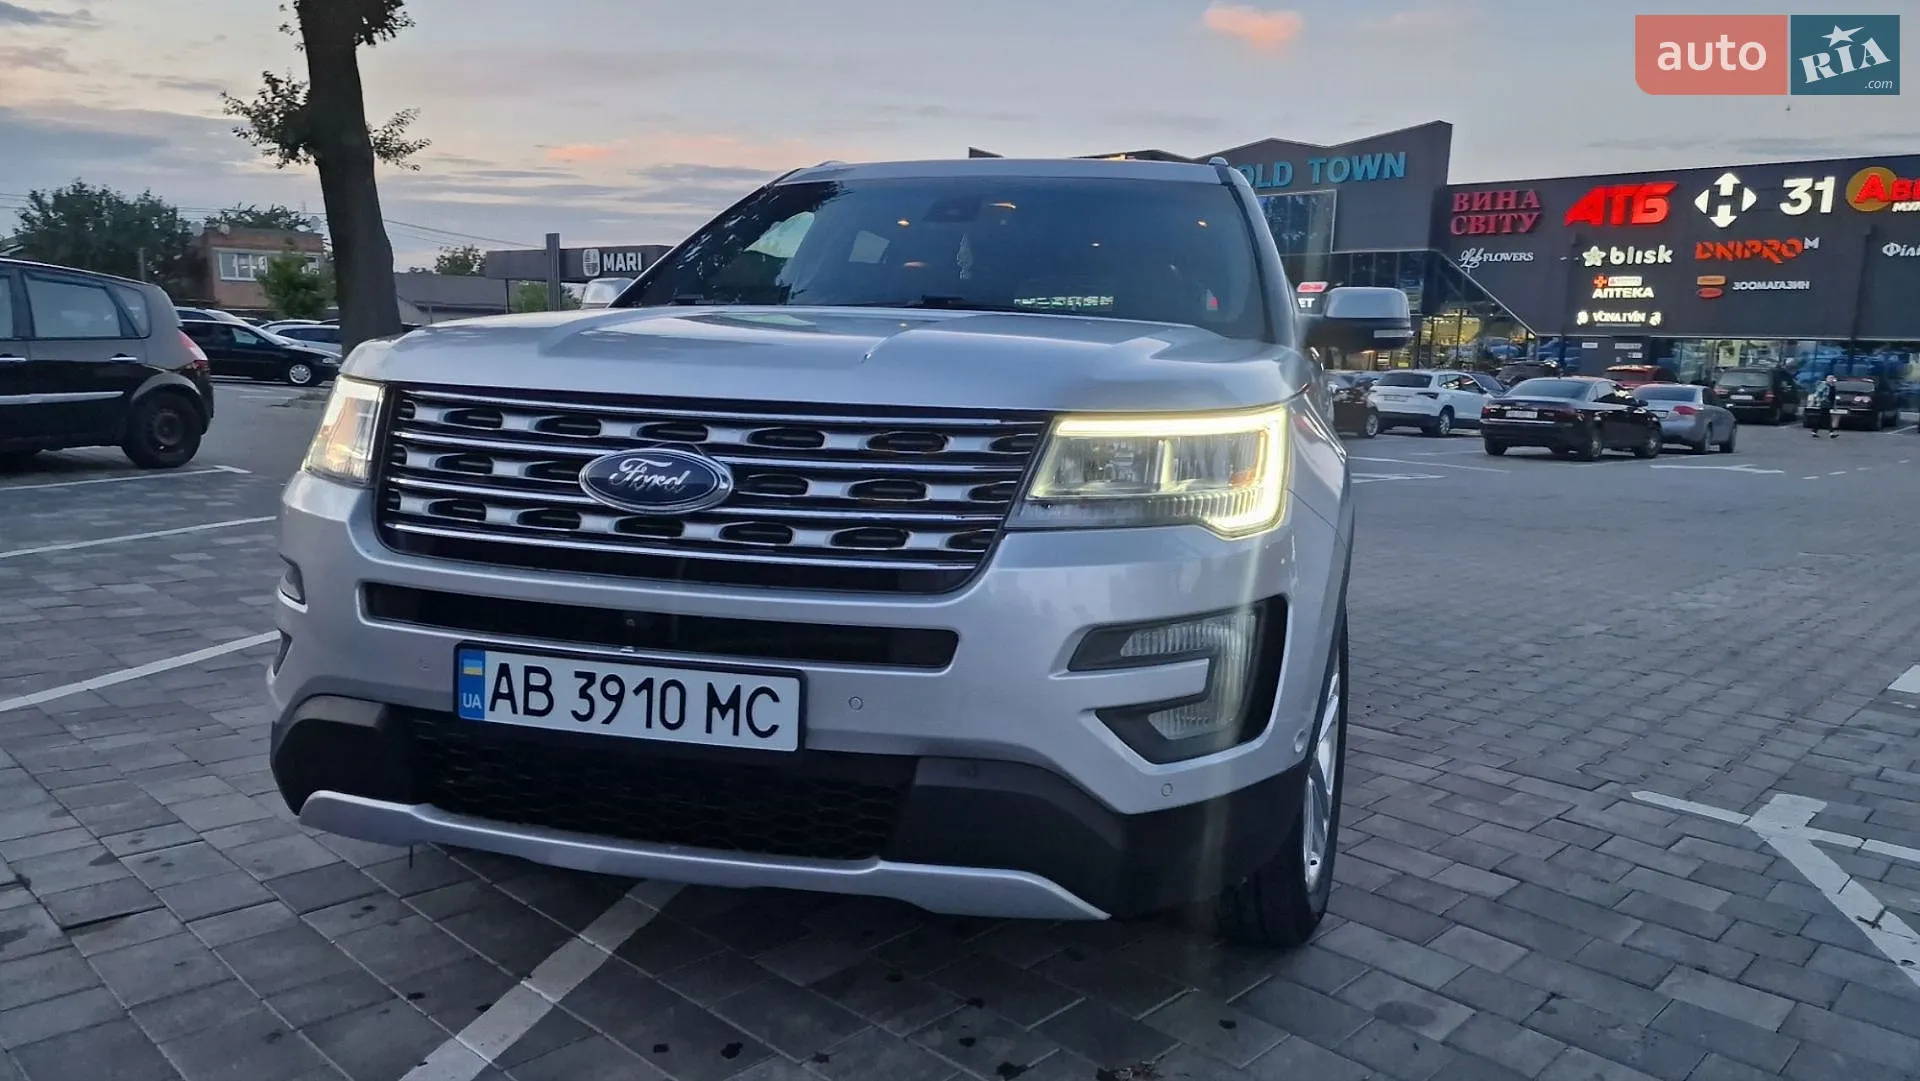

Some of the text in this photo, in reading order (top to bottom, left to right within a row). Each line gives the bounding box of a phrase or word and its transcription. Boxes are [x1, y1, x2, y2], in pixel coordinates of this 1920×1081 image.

[1239, 152, 1406, 188] OLD TOWN
[1452, 189, 1541, 212] ВИНА
[1564, 181, 1678, 226] АТБ
[1779, 176, 1836, 216] 31
[1450, 212, 1541, 235] СВІТУ
[603, 252, 642, 272] MARI
[1483, 252, 1534, 262] FLOWERS
[1609, 245, 1673, 265] blisk
[1695, 238, 1803, 263] DNIPRO
[1592, 287, 1654, 298] АПТЕКА
[1732, 281, 1810, 290] ЗООМАГАЗИН
[609, 458, 691, 487] Ford
[463, 692, 482, 710] UA
[489, 662, 780, 739] AB 3910 MC
